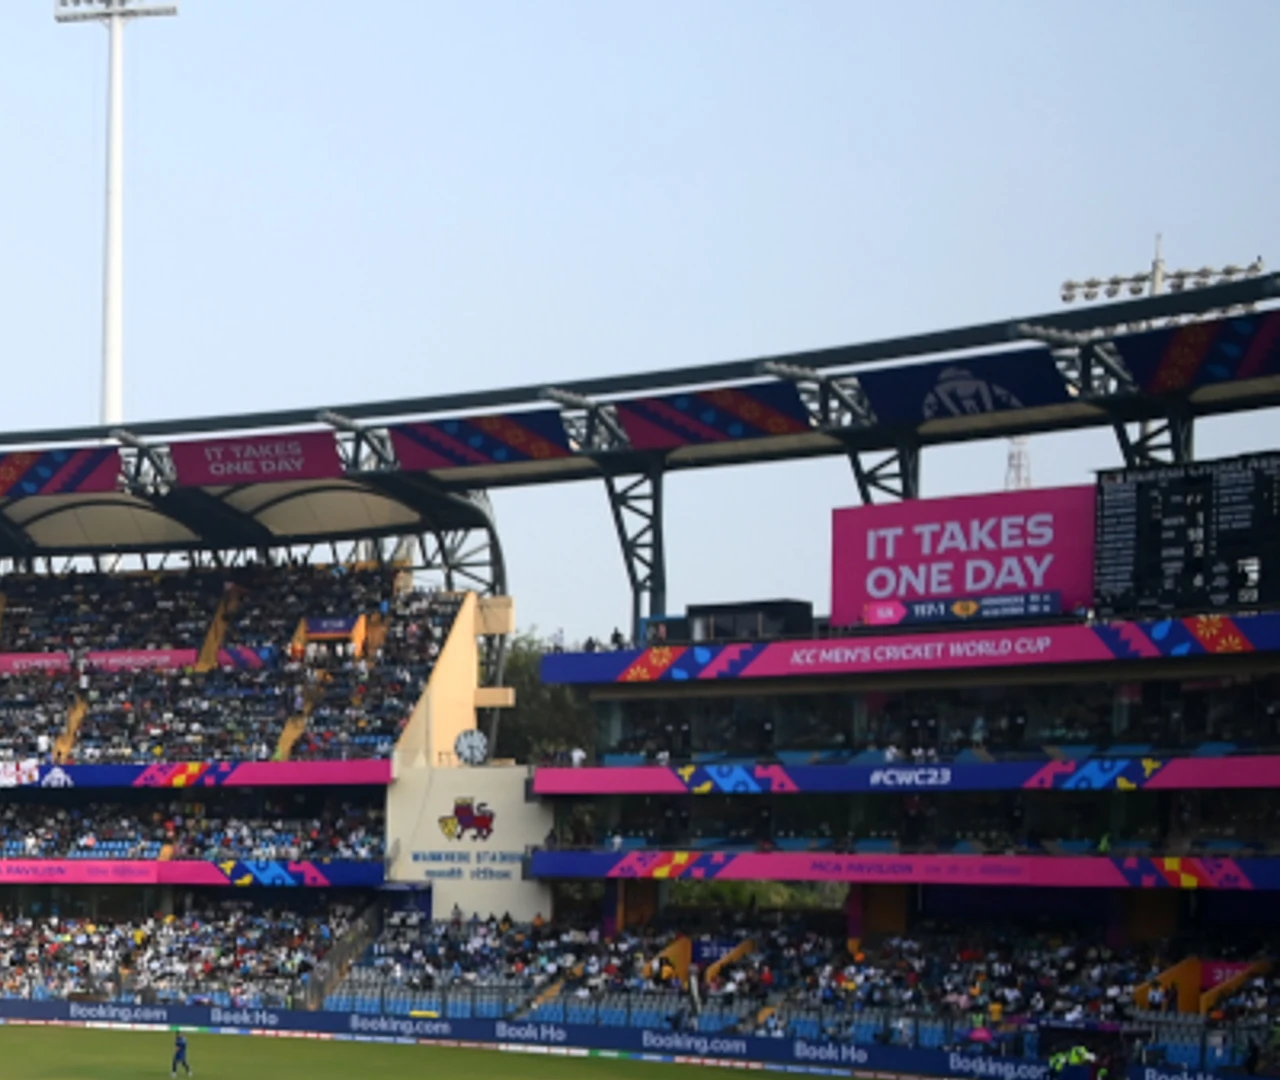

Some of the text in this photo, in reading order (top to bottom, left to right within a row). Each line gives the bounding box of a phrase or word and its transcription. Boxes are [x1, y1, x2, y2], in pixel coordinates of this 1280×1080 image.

[205, 440, 302, 461] IT TAKES
[209, 456, 305, 476] ONE DAY
[867, 513, 1054, 561] IT TAKES
[866, 554, 1054, 599] ONE DAY
[791, 636, 1052, 666] ICC MEN'S CRICKET WORLD CUP
[869, 767, 952, 787] #CWC23
[69, 1003, 167, 1023] Booking.com
[350, 1014, 451, 1036] Booking.com
[496, 1022, 567, 1042] Book Ho
[642, 1031, 747, 1056] Booking.com
[794, 1040, 868, 1064] Book Ho
